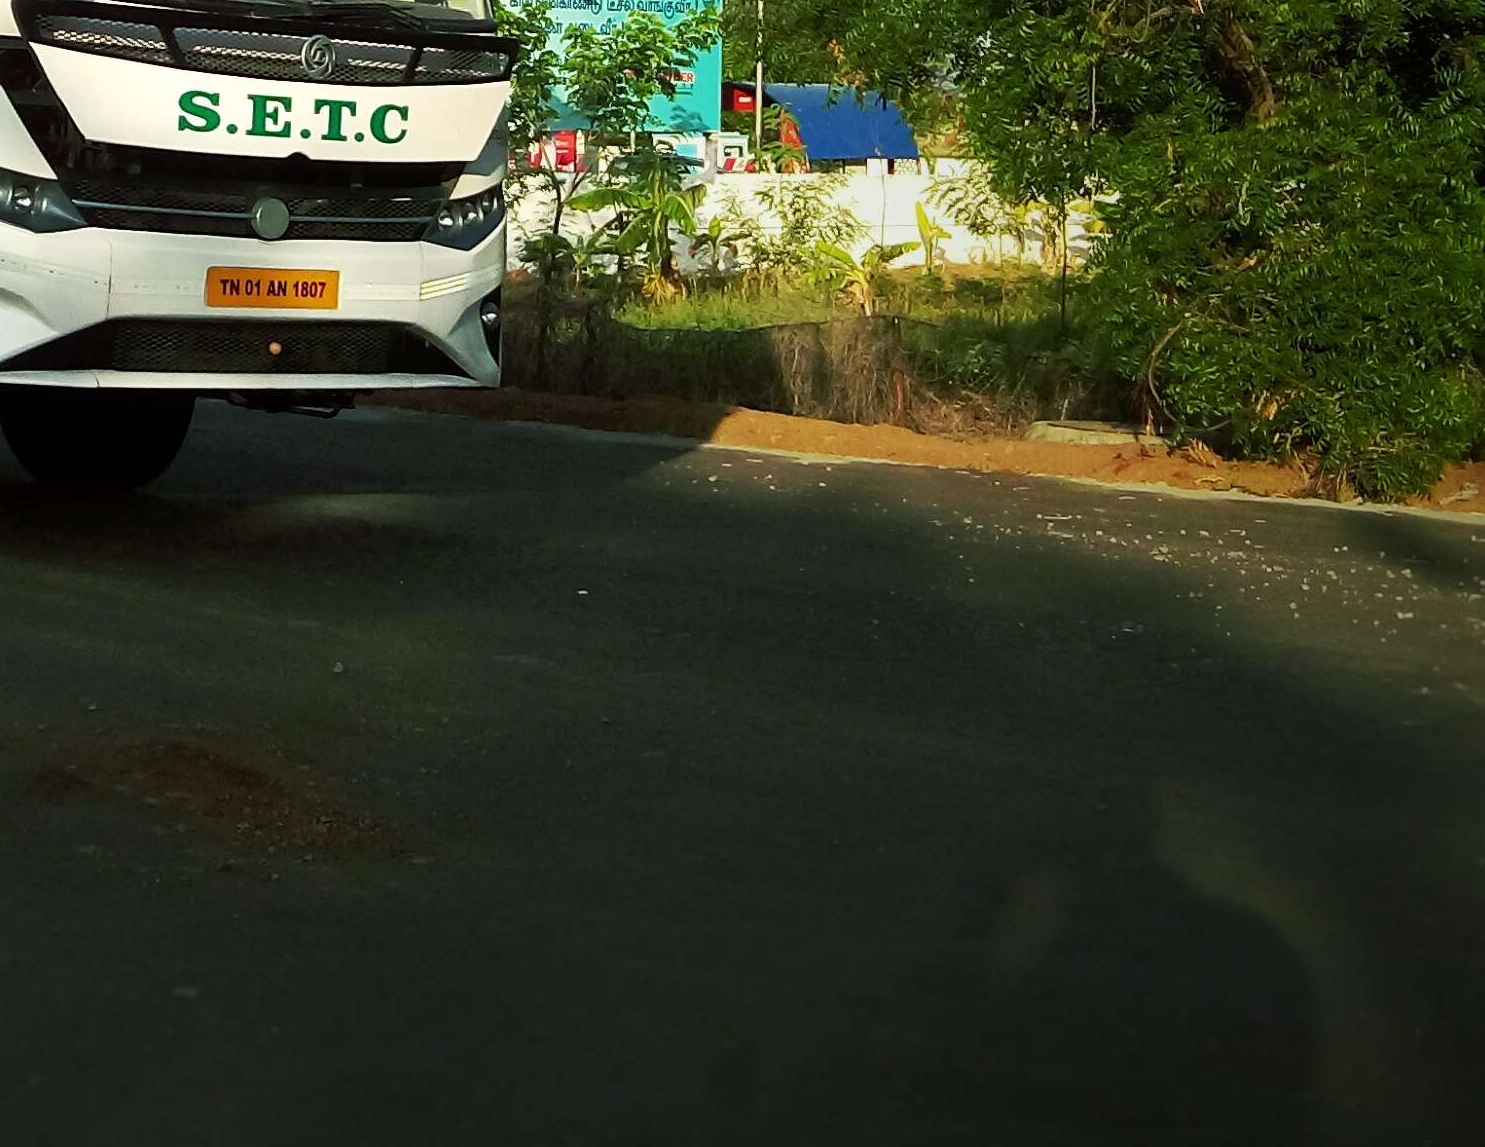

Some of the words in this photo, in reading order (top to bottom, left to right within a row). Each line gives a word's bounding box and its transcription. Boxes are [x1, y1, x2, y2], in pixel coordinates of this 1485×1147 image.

[178, 90, 409, 144] S.E.T.C
[220, 279, 240, 296] TN
[245, 280, 261, 296] 01
[267, 280, 287, 297] AN
[293, 281, 327, 298] 1807
